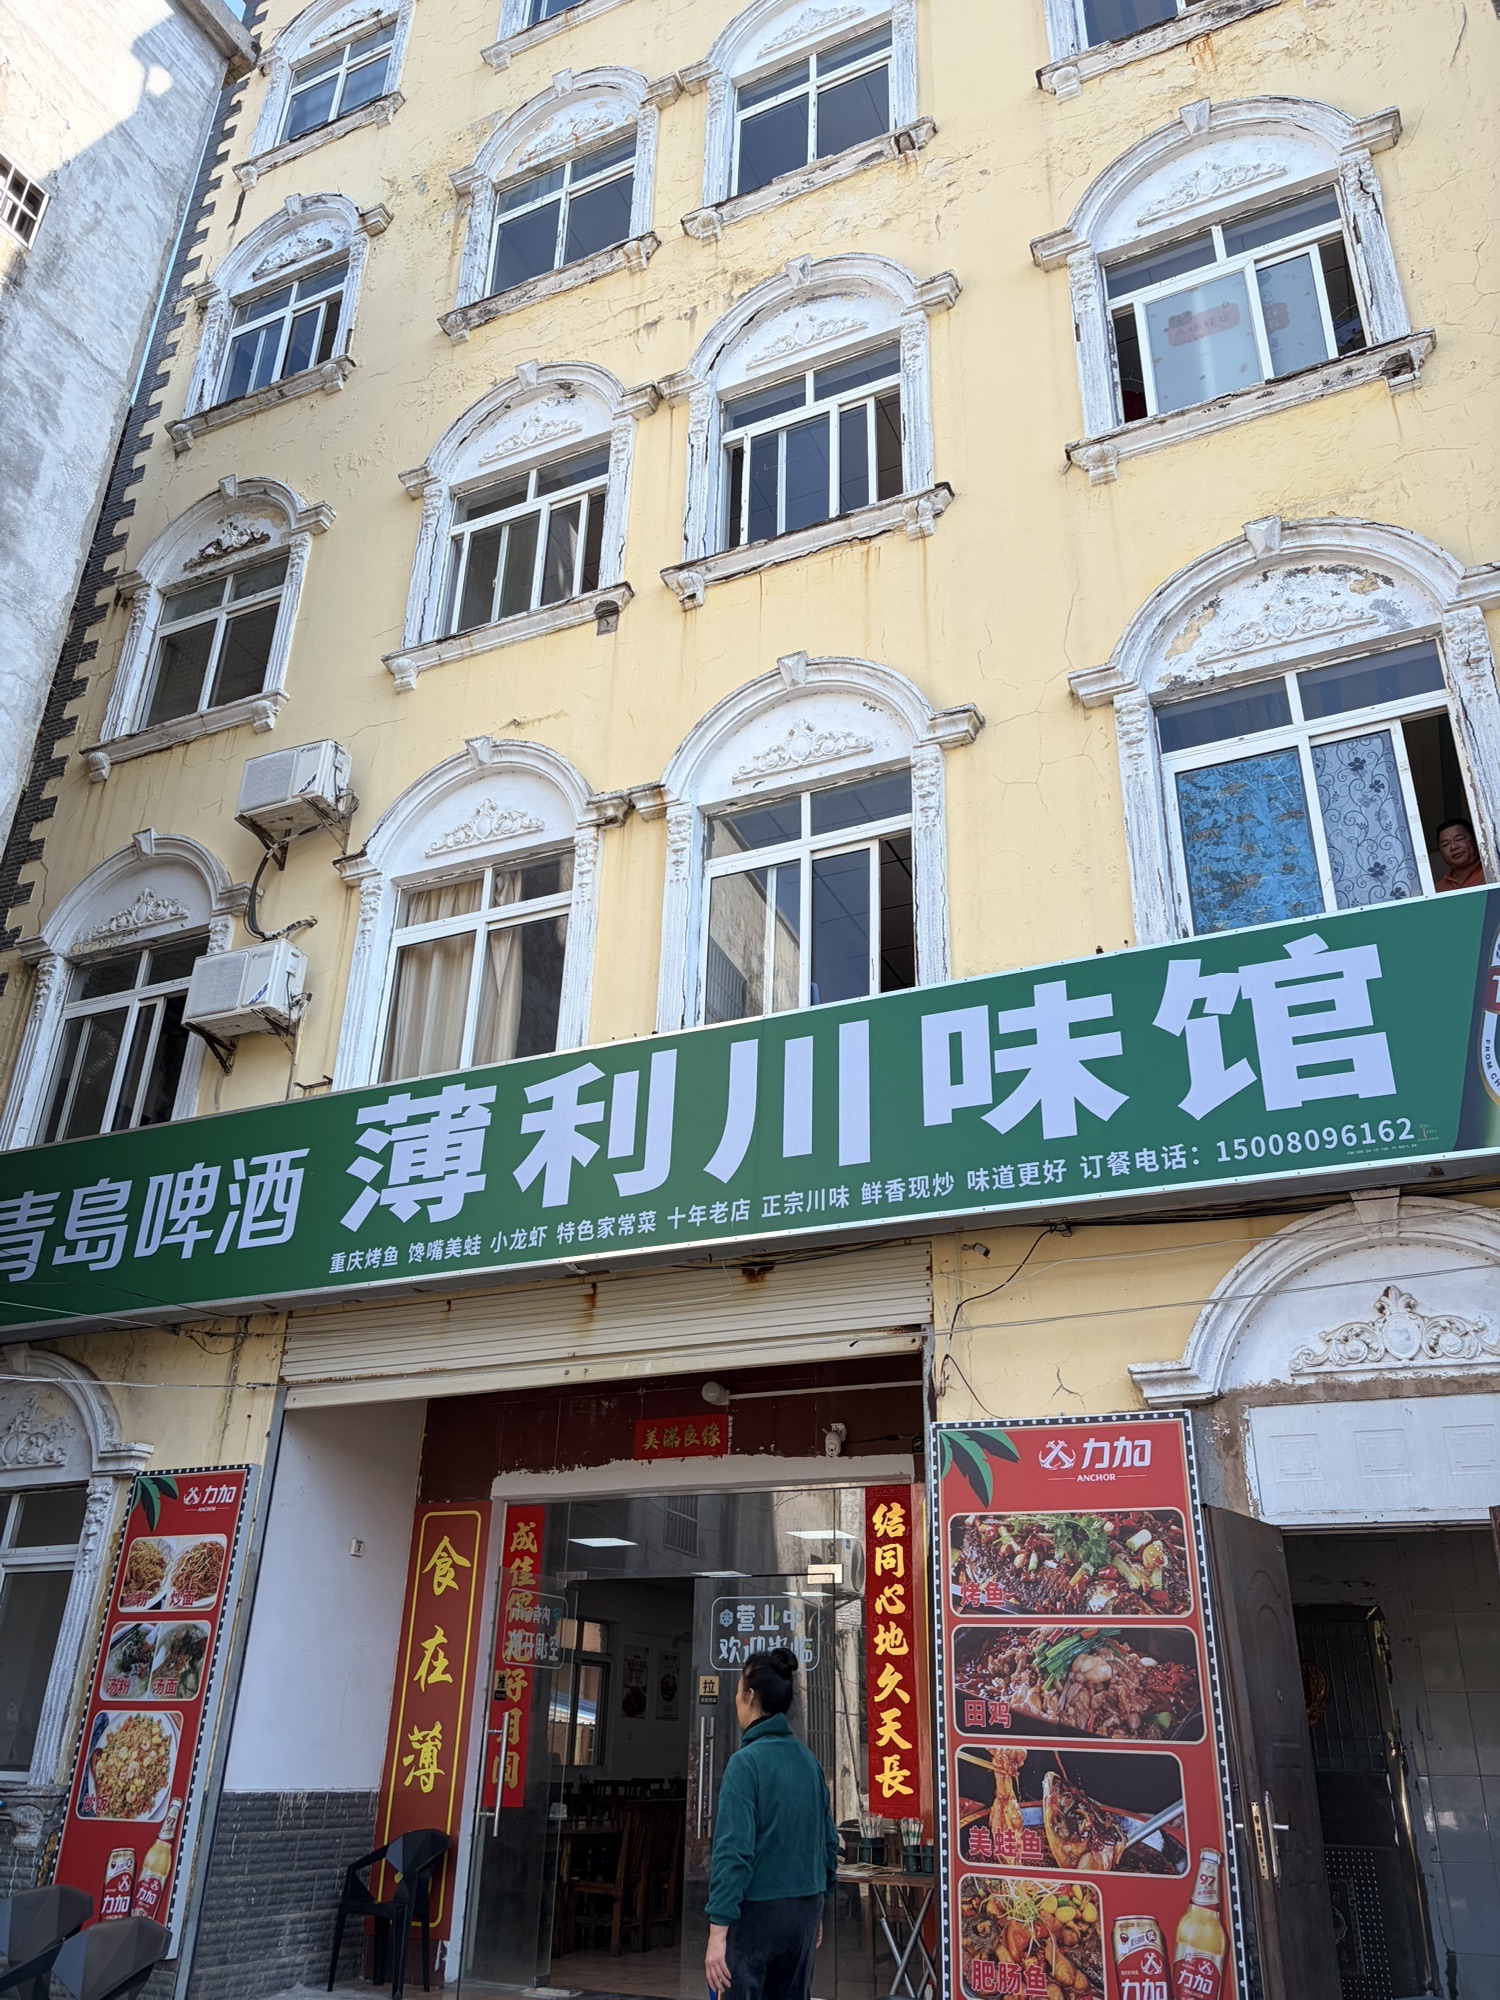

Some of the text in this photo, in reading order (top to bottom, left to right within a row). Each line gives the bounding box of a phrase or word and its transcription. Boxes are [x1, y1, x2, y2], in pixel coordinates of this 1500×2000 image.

[1484, 1039, 1493, 1070] FROM
[340, 934, 1397, 1232] 薄利川味馆
[328, 1245, 399, 1274] 重庆烤鱼
[407, 1234, 482, 1264] 馋嘴美蛙
[489, 1225, 548, 1253] 小龙虾
[556, 1210, 657, 1244] 特色家常菜
[667, 1198, 751, 1230] 十年老店
[761, 1185, 850, 1218] 正宗川味
[861, 1171, 955, 1206] 鲜香现炒
[967, 1158, 1068, 1193] 味道更好
[1215, 1117, 1416, 1165] 15008096162
[1081, 1436, 1152, 1469] 力加
[1076, 1473, 1116, 1482] ANCHOR
[202, 1484, 237, 1504] 力加
[169, 1589, 196, 1606] 炒面
[960, 1581, 1006, 1607] 烤鱼
[736, 1604, 803, 1632] 营业中
[106, 1676, 179, 1696] 汤粉 汤面
[703, 1679, 715, 1694] 拉
[394, 1535, 472, 1895] 食在薄
[964, 1699, 1011, 1729] 田鸡
[968, 1825, 1043, 1860] 美蛙鱼
[1200, 1873, 1216, 1887] 97
[101, 1894, 131, 1914] 力加
[136, 1886, 157, 1905] 力加
[971, 1958, 1049, 1997] 肥肠鱼
[1177, 1969, 1214, 1995] 力加
